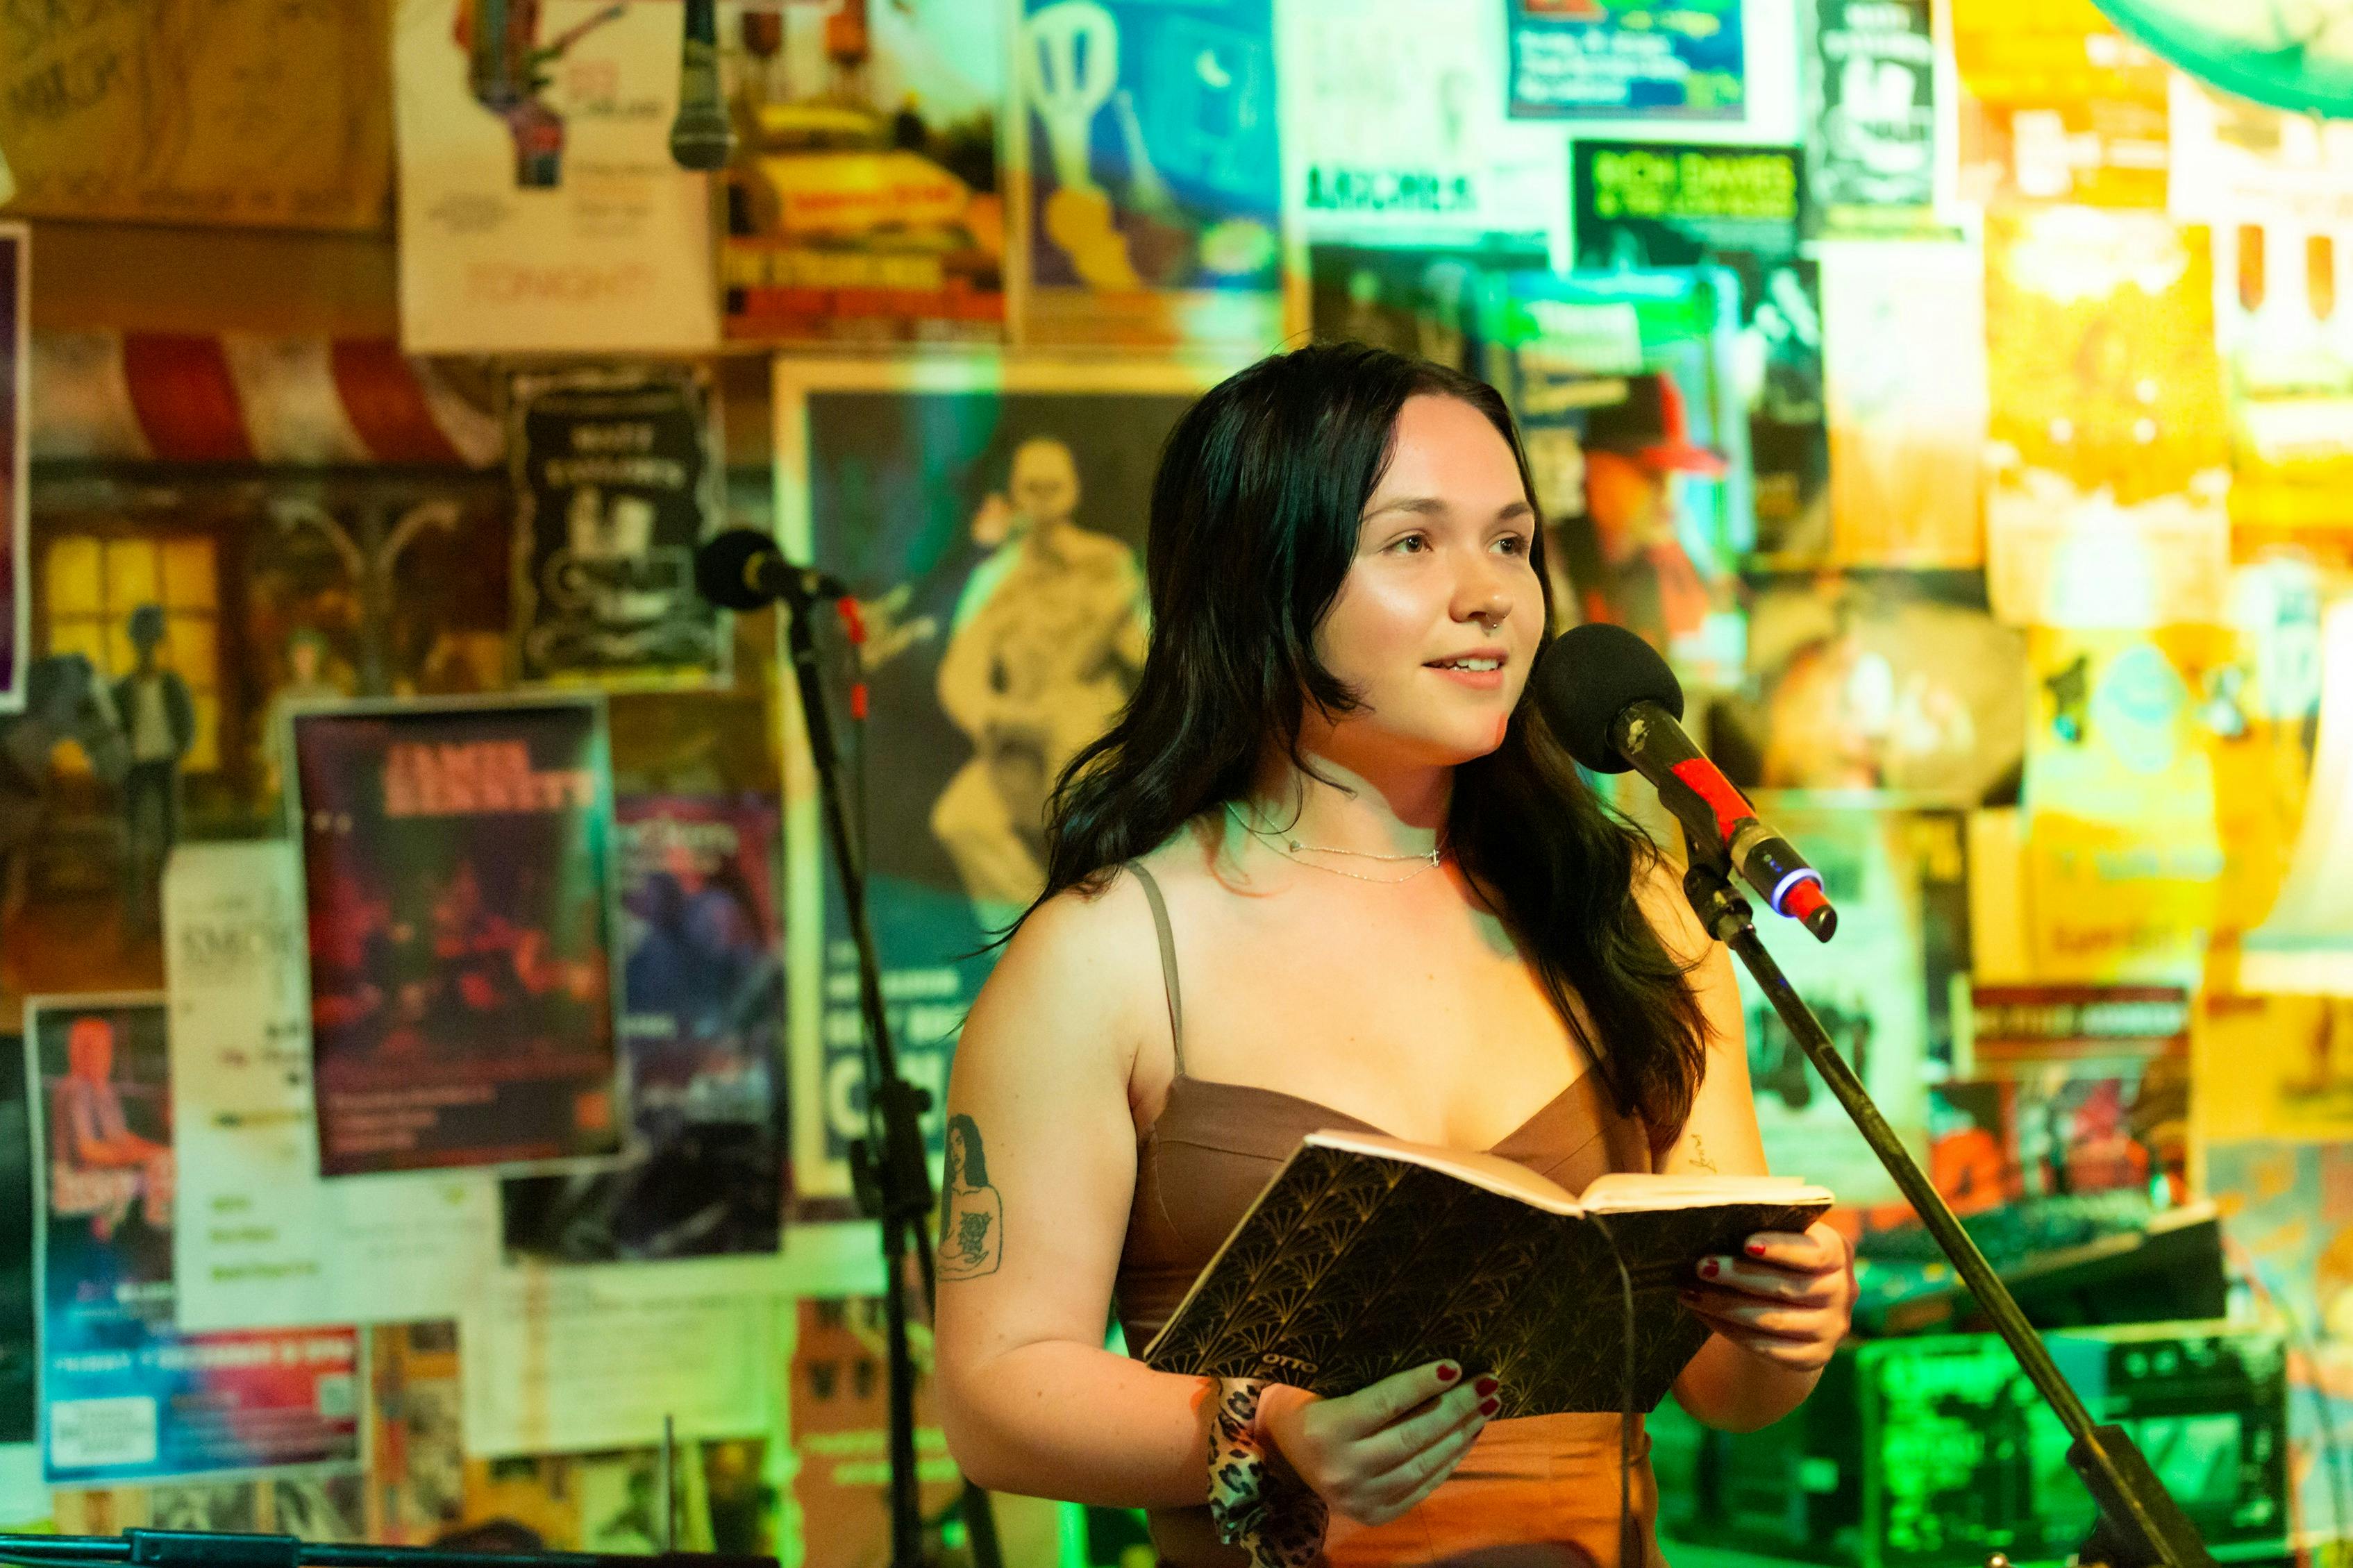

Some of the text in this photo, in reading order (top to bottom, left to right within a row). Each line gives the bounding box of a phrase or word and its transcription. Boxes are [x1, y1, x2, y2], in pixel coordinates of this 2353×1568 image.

[387, 740, 528, 775] JAMIE
[385, 770, 594, 816] BENNETT
[1263, 1354, 1318, 1373] OTTO
